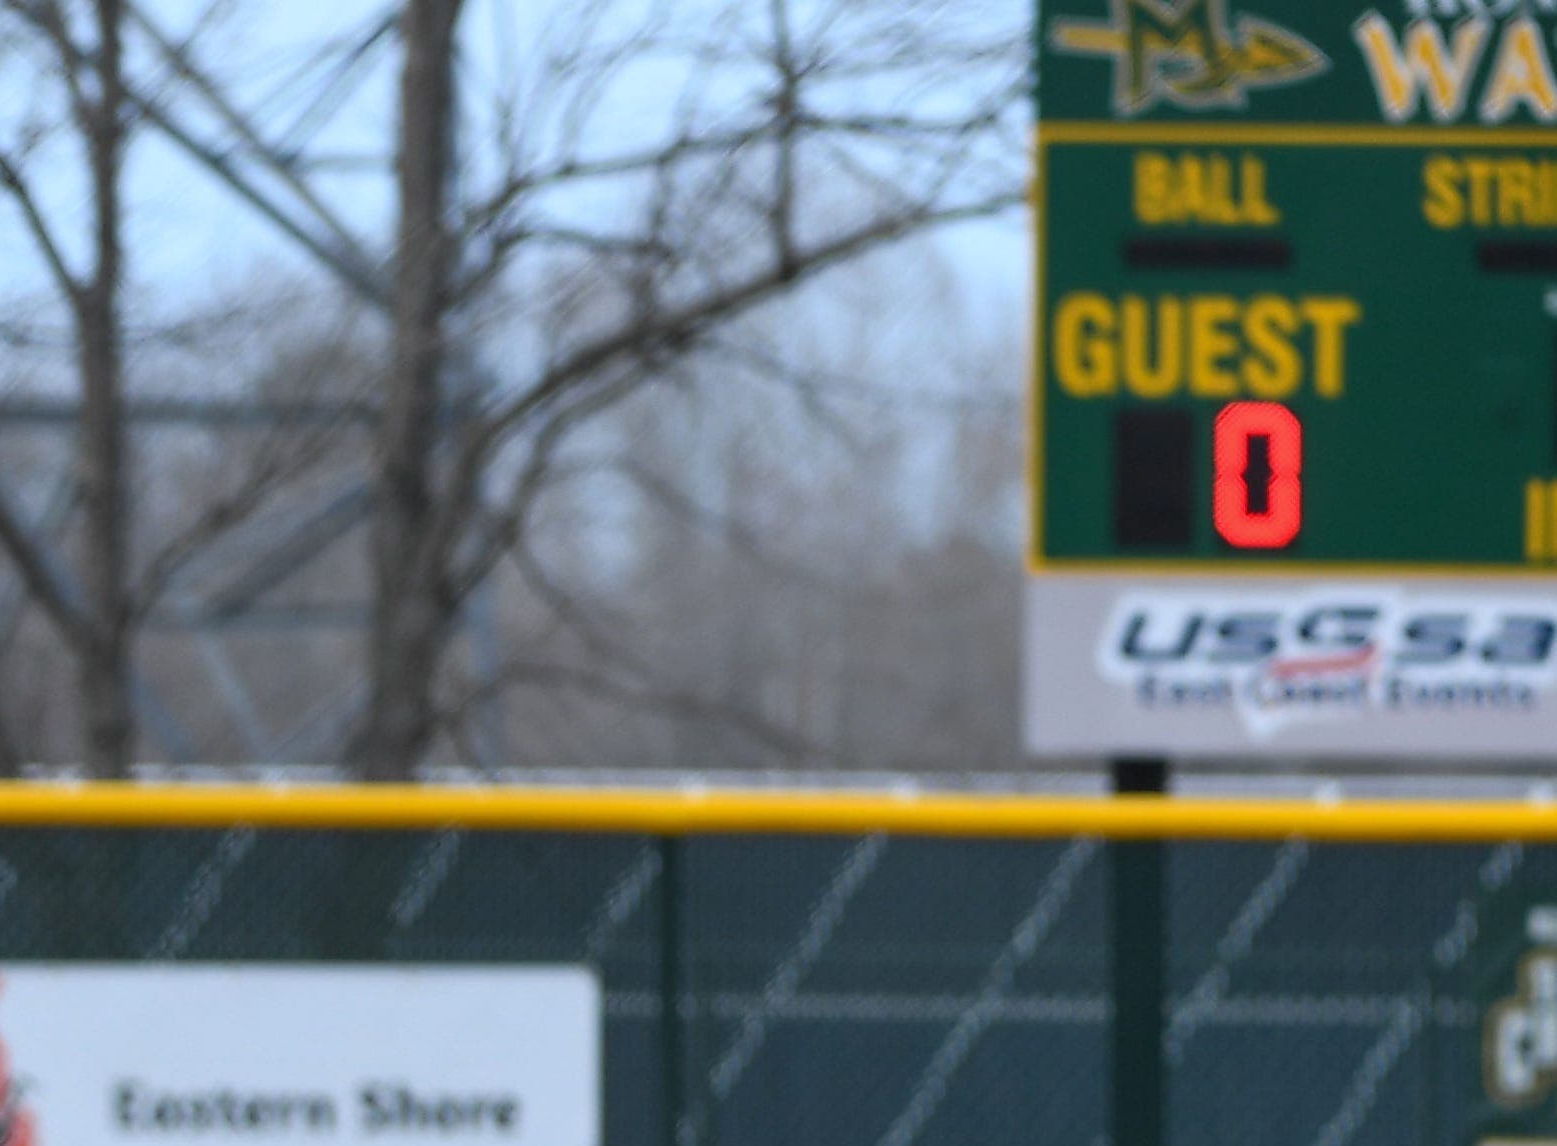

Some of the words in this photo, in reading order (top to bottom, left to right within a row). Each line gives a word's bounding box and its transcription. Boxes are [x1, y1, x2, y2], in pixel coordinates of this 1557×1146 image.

[1134, 153, 1281, 225] BALL
[1053, 293, 1362, 398] GUEST
[1213, 400, 1302, 551] 0
[110, 1080, 338, 1135] Eastern
[356, 1080, 521, 1136] Shore
